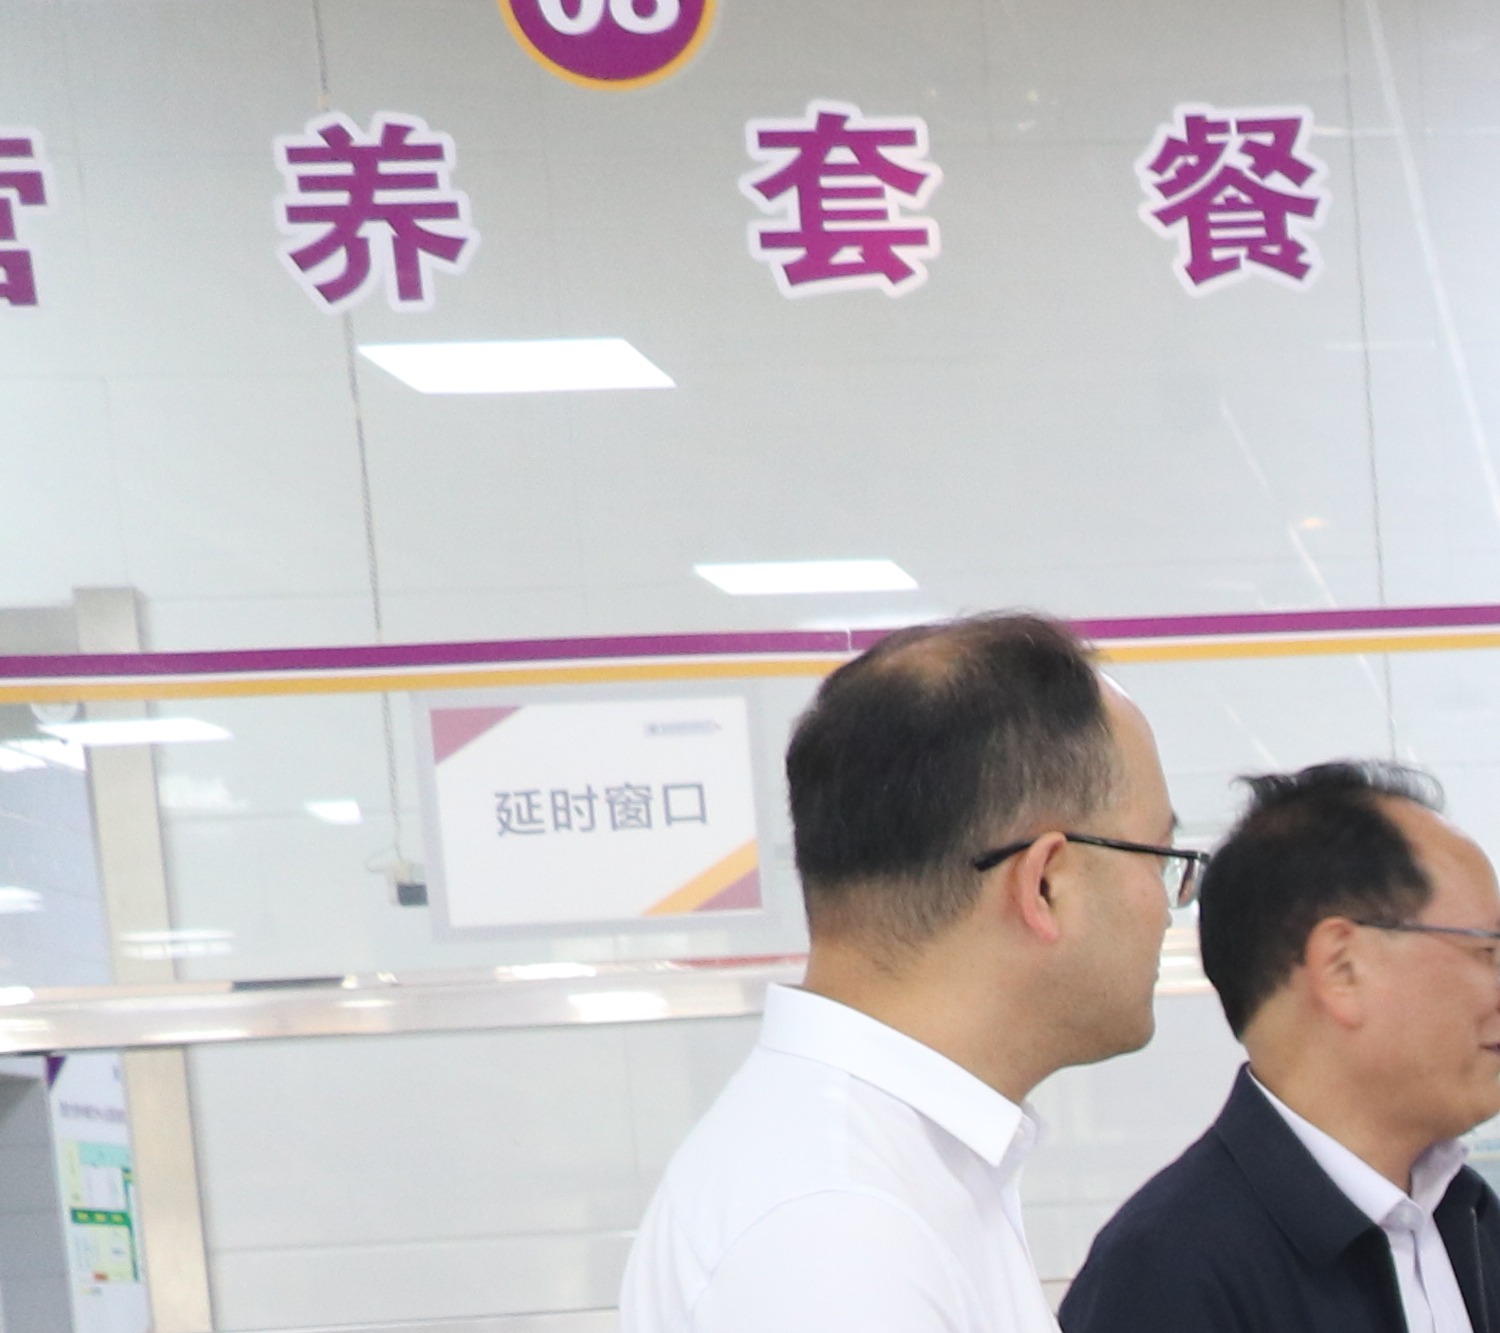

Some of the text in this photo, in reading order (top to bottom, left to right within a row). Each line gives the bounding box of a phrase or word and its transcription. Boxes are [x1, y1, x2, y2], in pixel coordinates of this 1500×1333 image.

[0, 109, 1324, 308] 养套餐
[494, 781, 710, 838] 延时窗口
